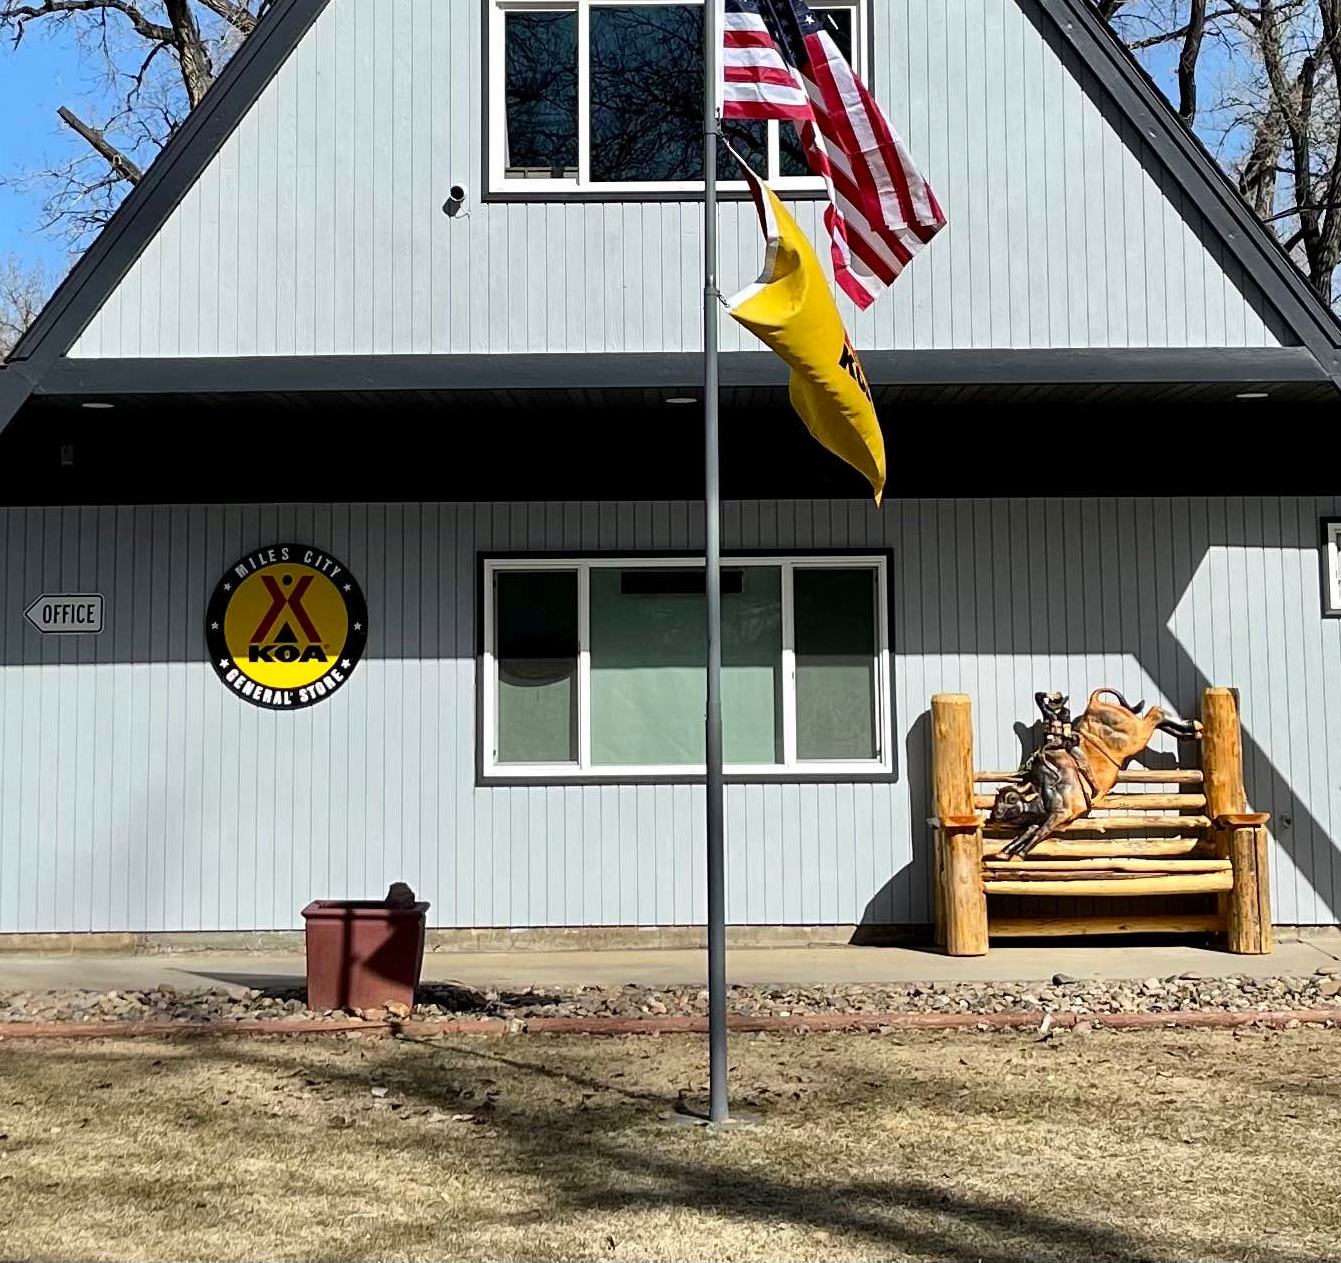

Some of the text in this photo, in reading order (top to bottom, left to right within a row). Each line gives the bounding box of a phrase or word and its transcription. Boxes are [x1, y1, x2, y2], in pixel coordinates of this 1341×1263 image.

[235, 548, 342, 578] MILES CITY
[43, 604, 95, 624] OFFICE
[248, 644, 328, 663] KOA
[226, 668, 344, 704] GENERAL STORE
